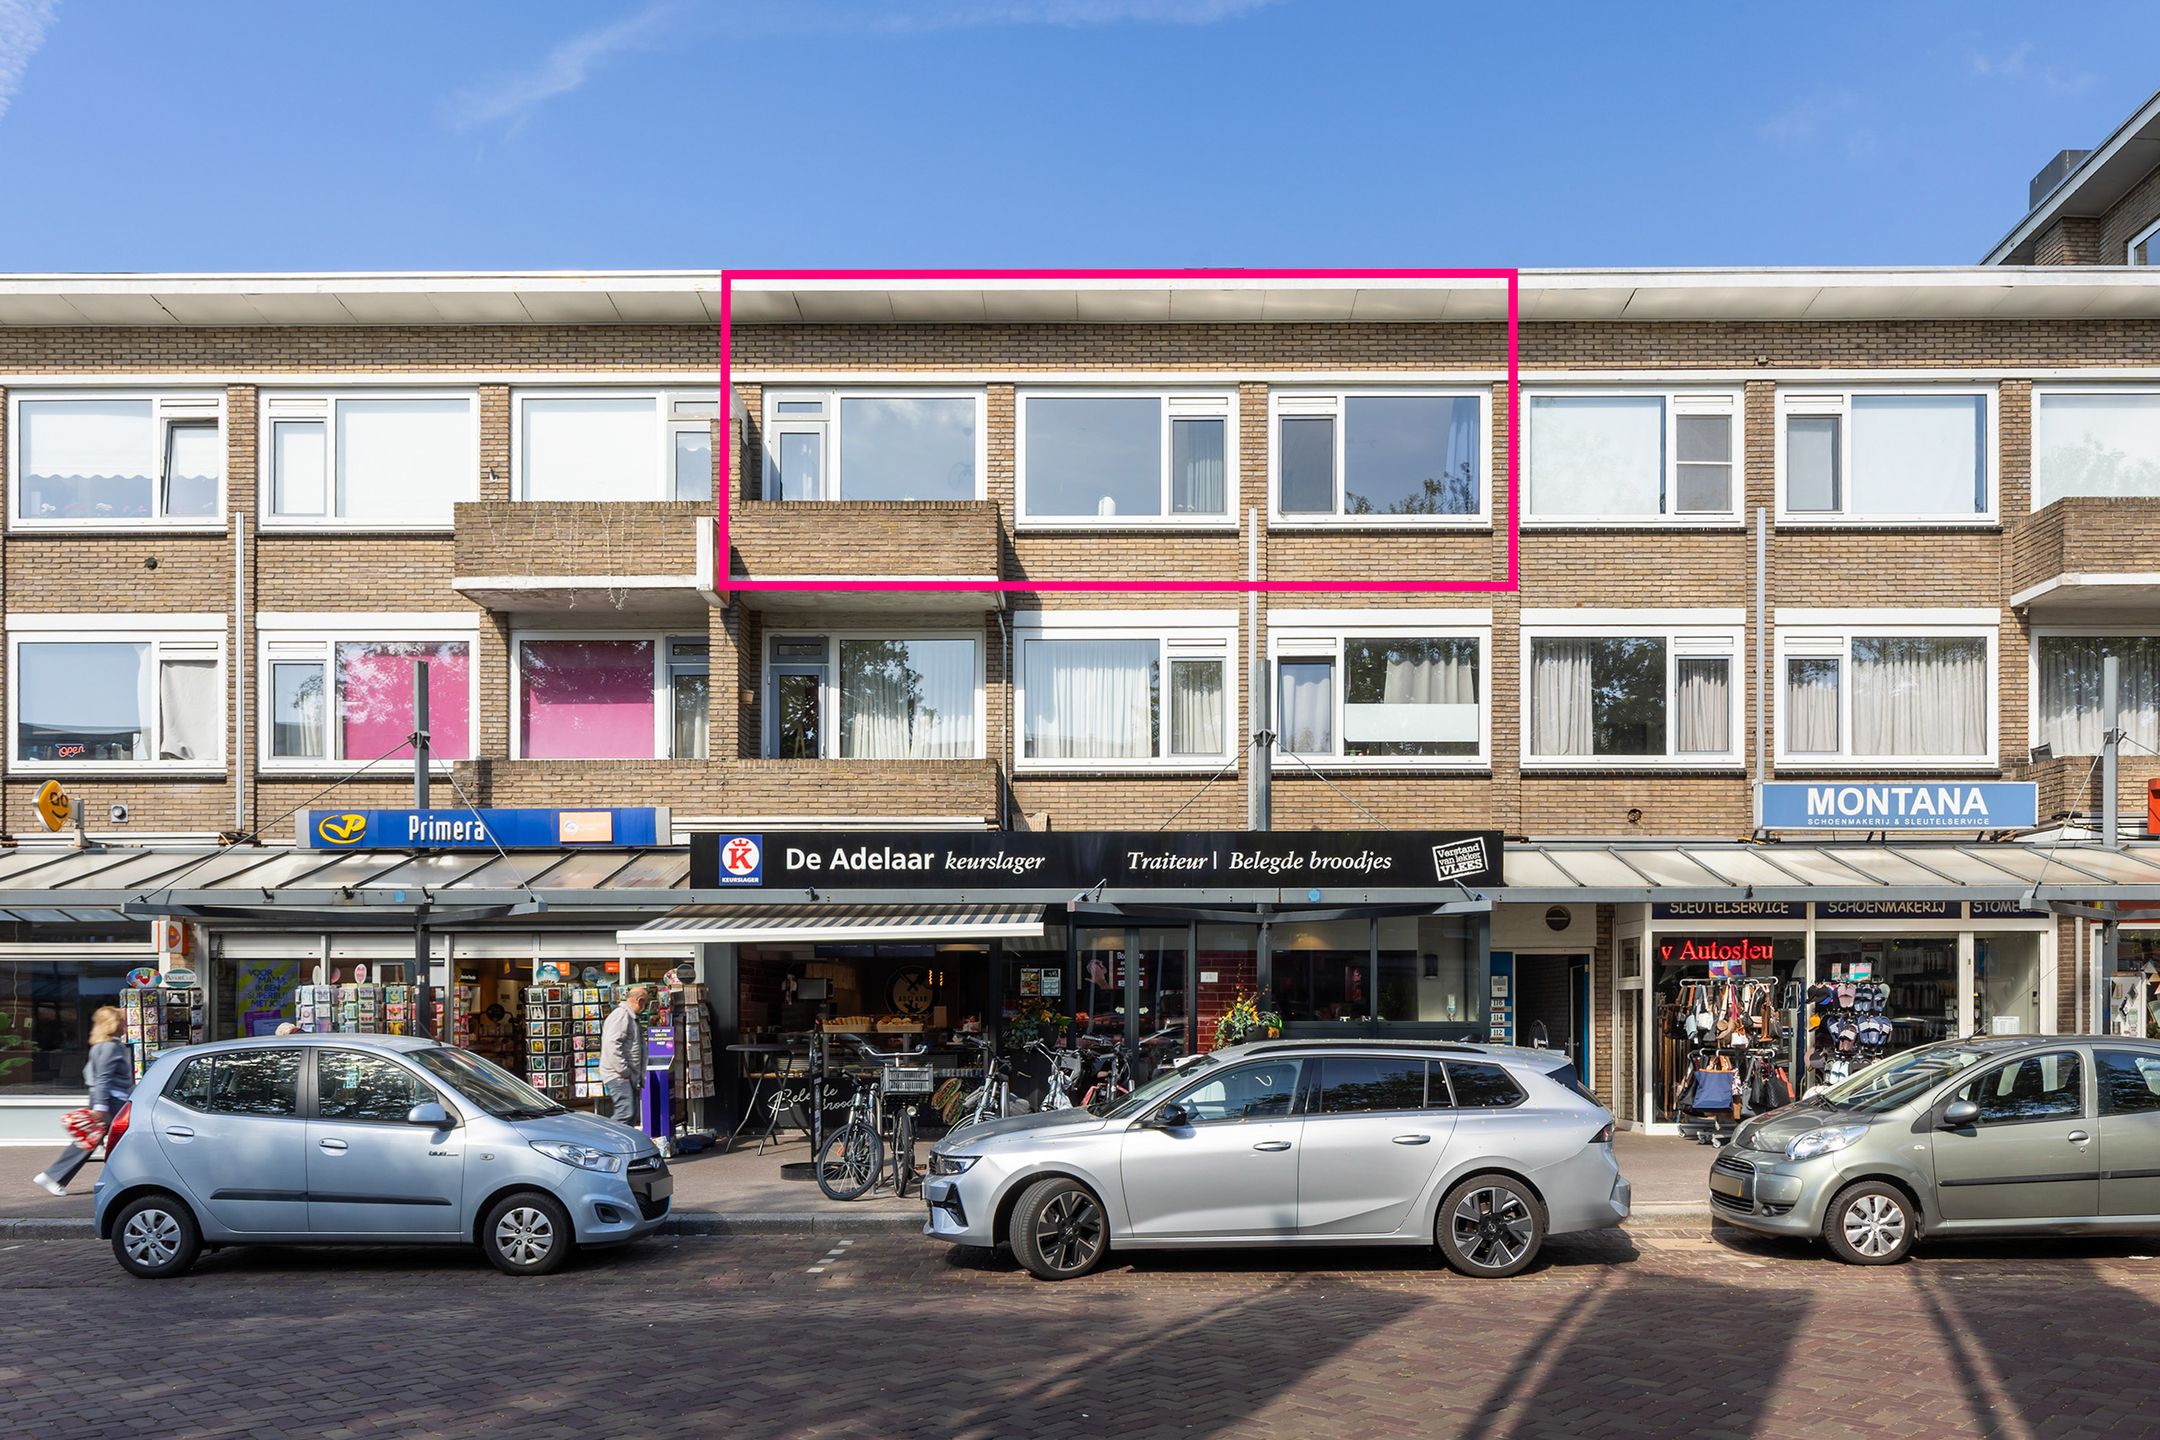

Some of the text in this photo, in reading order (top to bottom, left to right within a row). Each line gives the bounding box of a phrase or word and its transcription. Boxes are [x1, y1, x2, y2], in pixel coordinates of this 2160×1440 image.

[1807, 787, 1989, 816] MONTANA
[408, 815, 485, 842] Primera
[1807, 818, 1990, 826] SCHOENMAKERIJ & SLEUTELSERVICE
[728, 848, 753, 869] K
[1437, 843, 1480, 858] Verstand
[1439, 851, 1481, 866] van lekker
[786, 846, 1046, 875] De Adelaar keurslager
[1127, 851, 1209, 870] Traiteur
[1228, 850, 1304, 875] Belegde
[1309, 850, 1392, 875] broodjes
[1440, 859, 1483, 876] VLEES
[1669, 902, 1789, 914] SLEUTELSERVICE
[1827, 902, 1946, 914] SCHOENMAKERIJ
[1679, 939, 1773, 961] Autosleu
